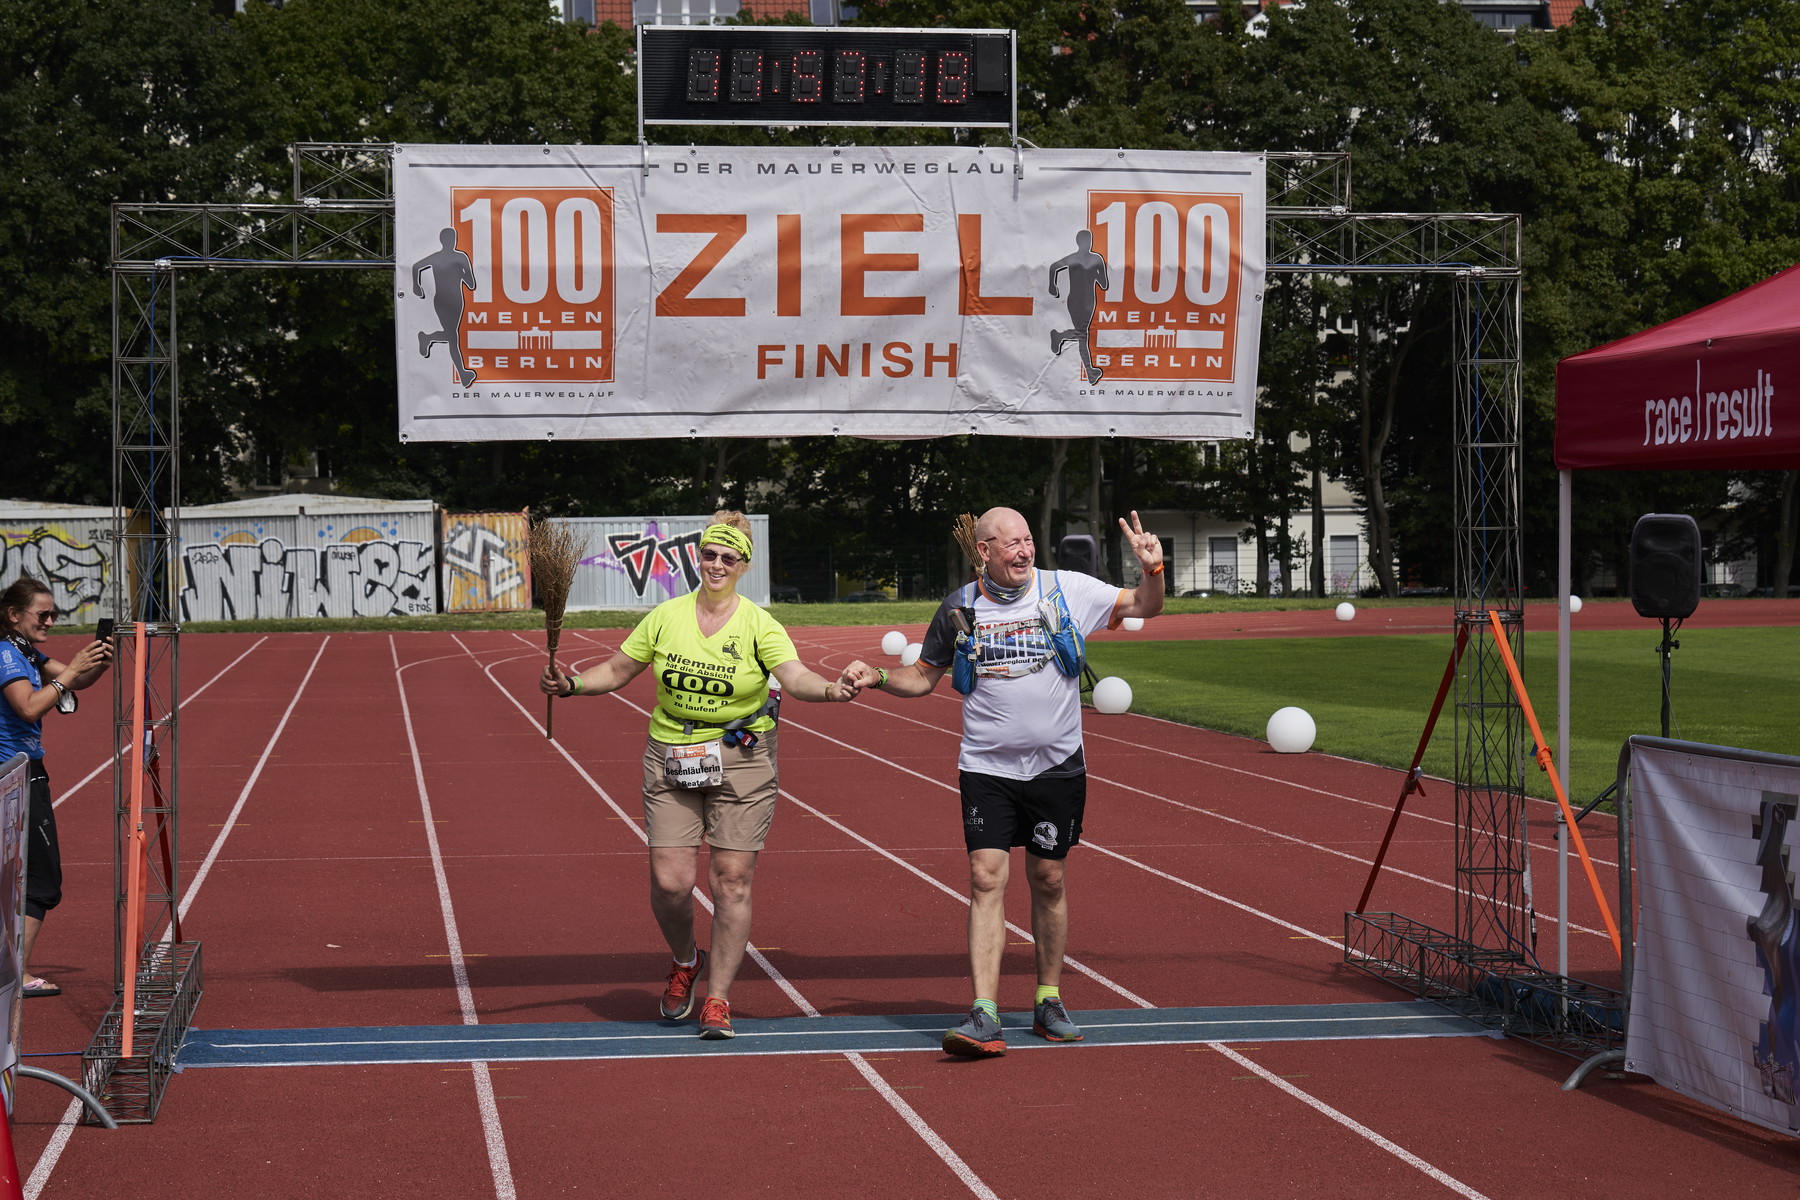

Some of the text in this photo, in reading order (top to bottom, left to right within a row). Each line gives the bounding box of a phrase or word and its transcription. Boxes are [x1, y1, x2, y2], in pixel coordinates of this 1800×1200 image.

[704, 50, 969, 103] 11:57:18
[673, 162, 734, 175] DER
[460, 197, 602, 305] 100
[1095, 201, 1230, 306] 100
[656, 213, 1034, 317] ZIEL
[468, 311, 603, 324] MEILEN
[1098, 311, 1226, 324] MEILEN
[468, 355, 603, 369] BERLIN
[757, 342, 958, 379] FINISH
[1096, 354, 1222, 368] BERLIN
[452, 390, 615, 399] DER MAUERWEGLAUF
[1115, 389, 1234, 397] MAUERWEGLAUF
[666, 662, 734, 681] hat die Absicht
[667, 653, 736, 675] Niemand
[666, 672, 727, 695] 100
[665, 688, 729, 706] Meilen
[674, 701, 718, 713] zu laufen!
[665, 765, 721, 776] Besenläuferin
